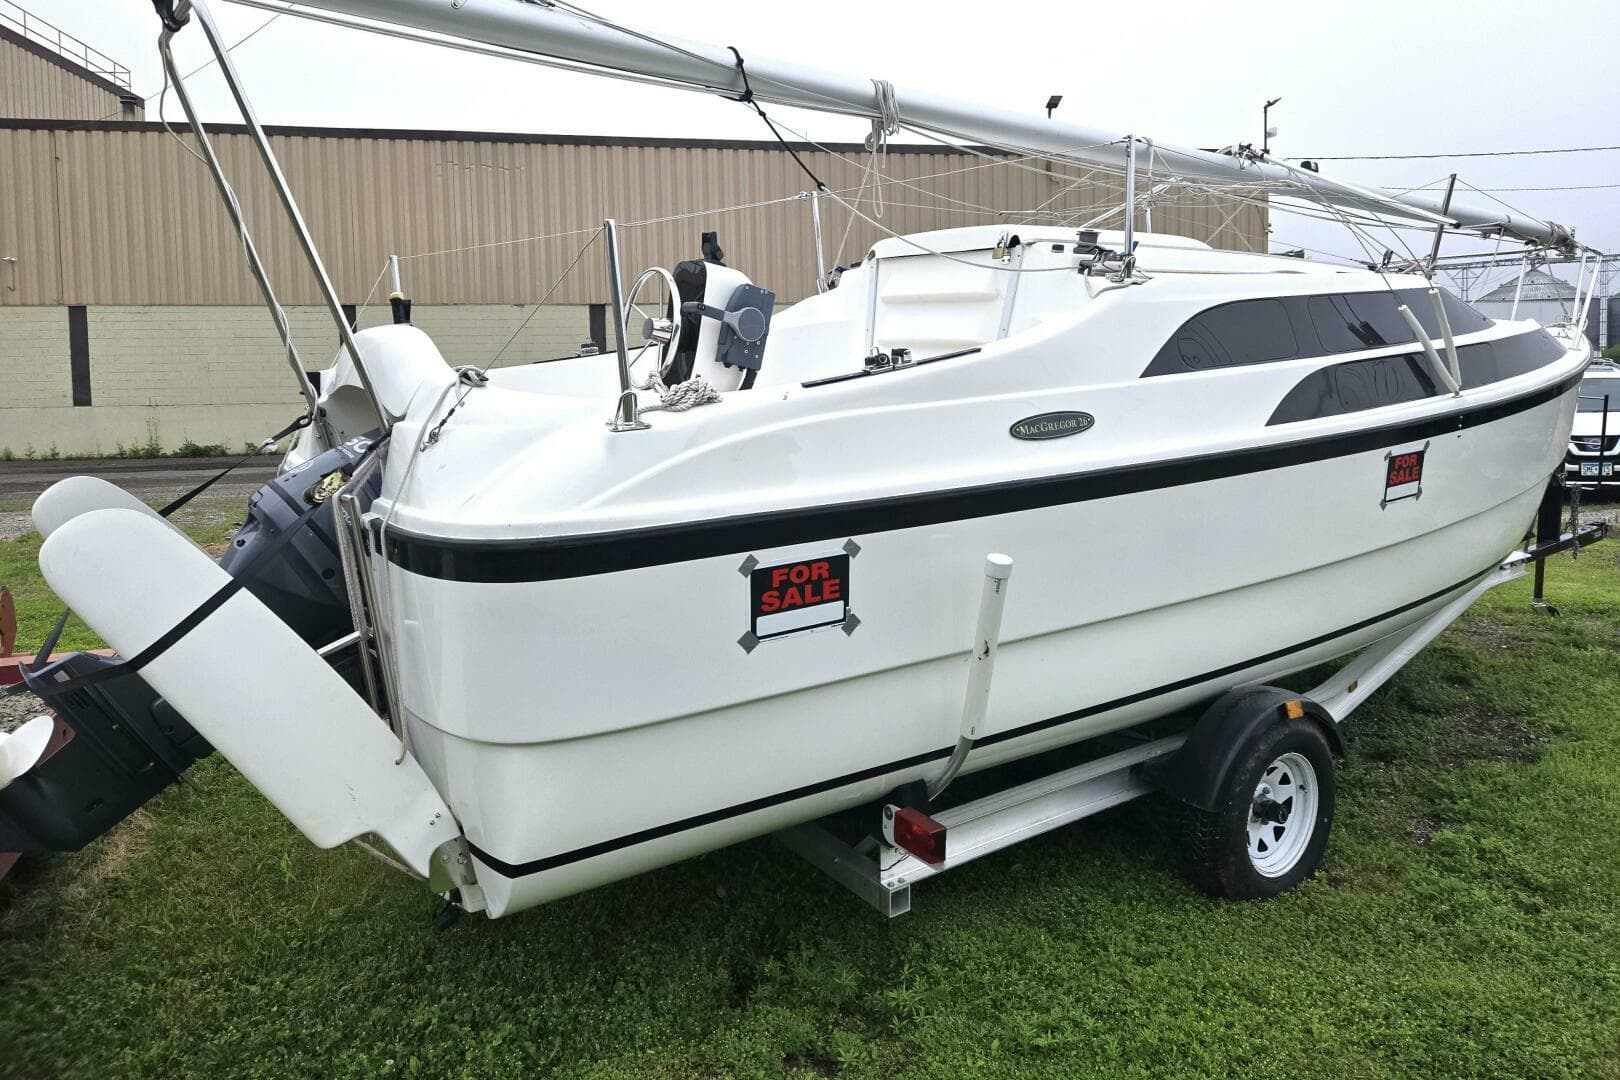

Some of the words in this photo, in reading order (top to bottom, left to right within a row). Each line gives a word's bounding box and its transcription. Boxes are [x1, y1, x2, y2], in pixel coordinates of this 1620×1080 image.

[1394, 454, 1419, 470] FOR
[1389, 466, 1420, 486] SALE
[771, 561, 830, 589] FOR
[761, 578, 840, 612] SALE
